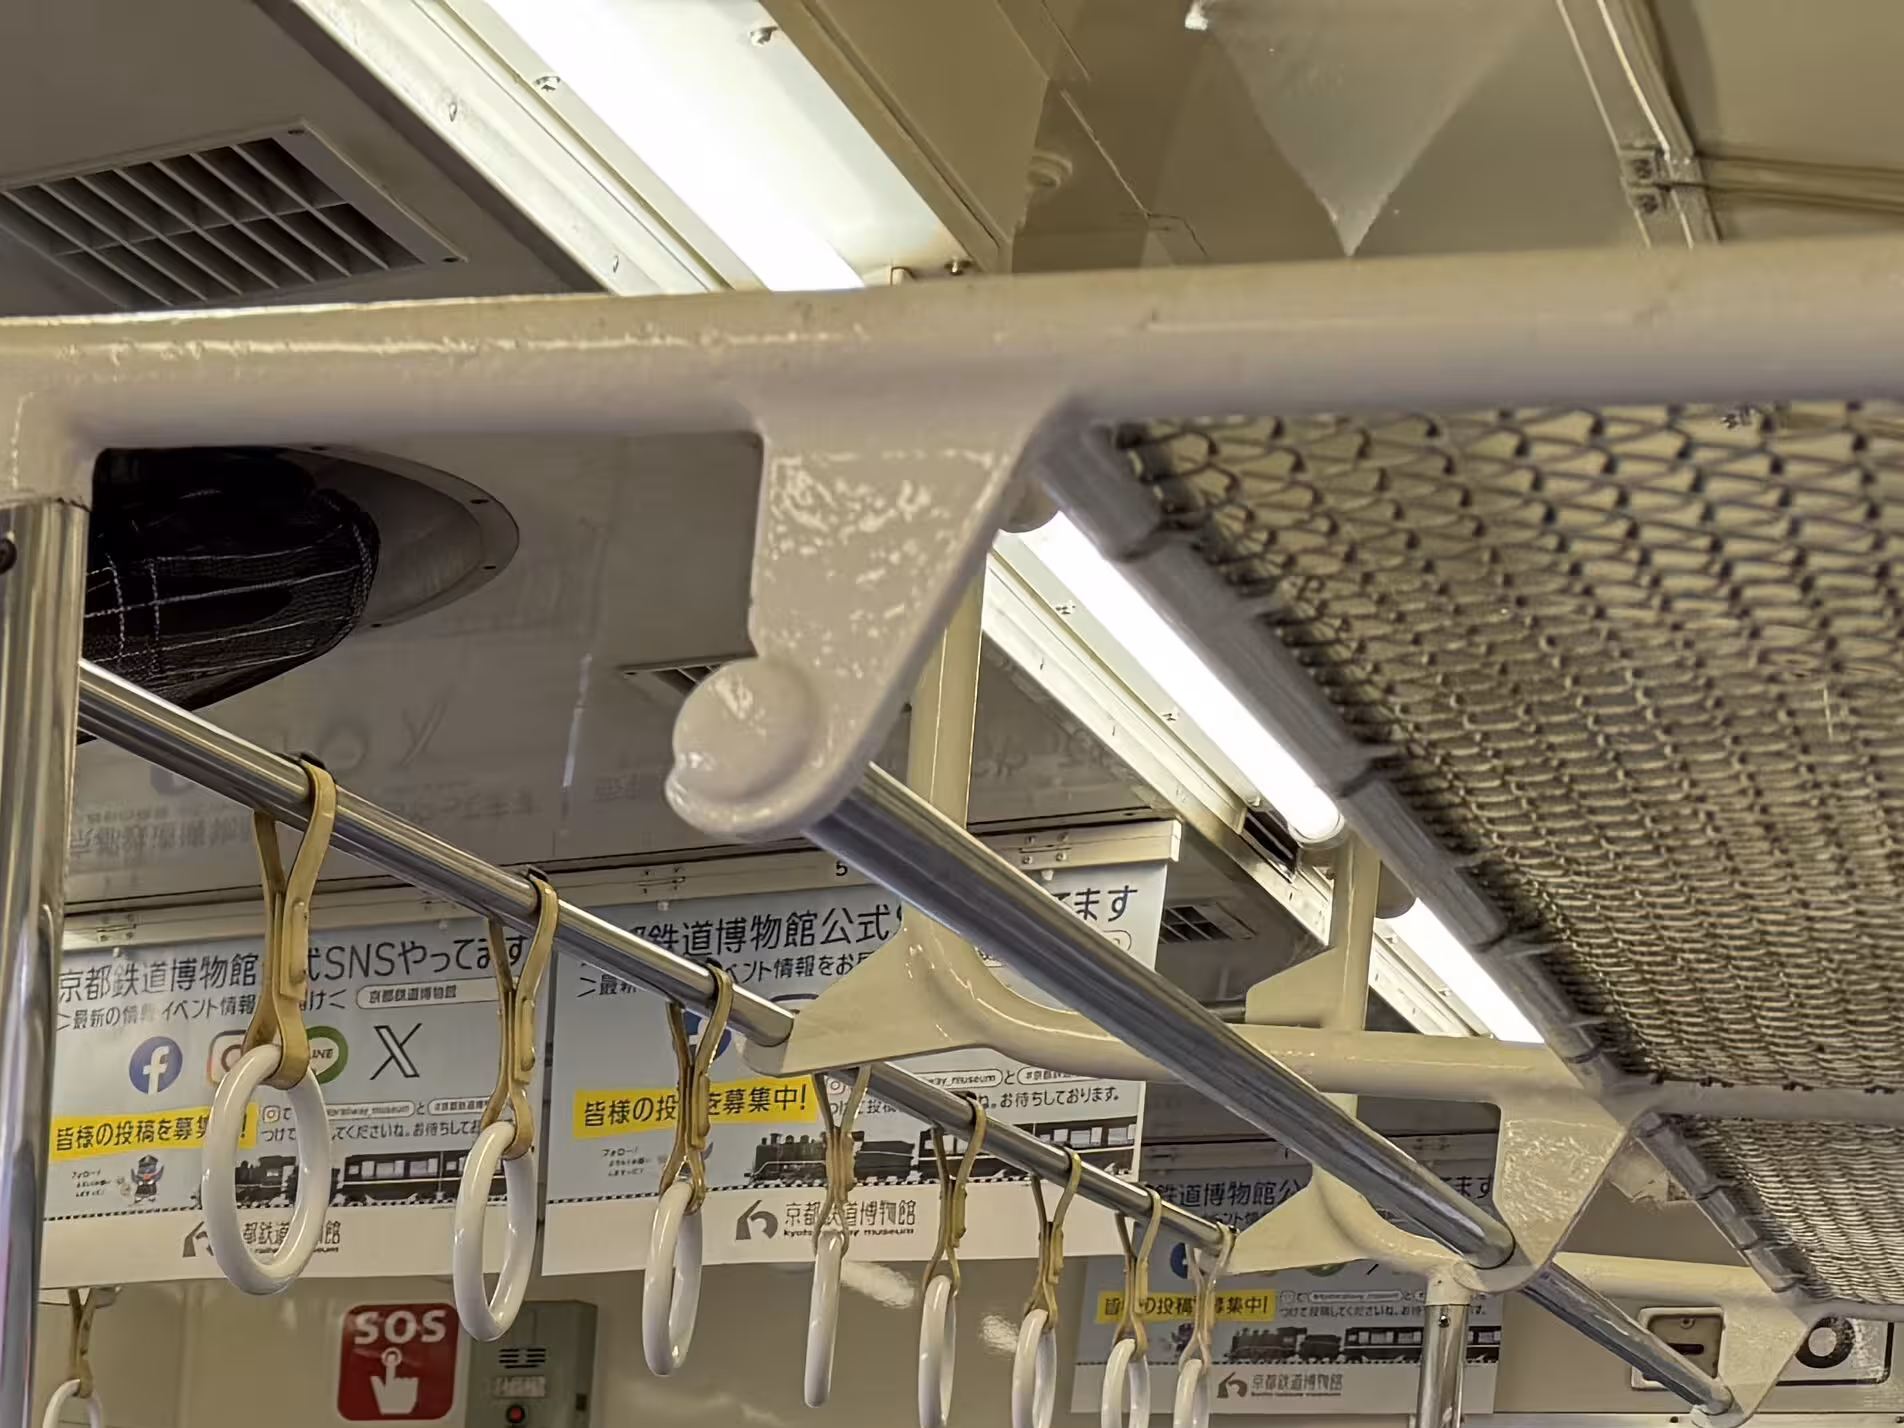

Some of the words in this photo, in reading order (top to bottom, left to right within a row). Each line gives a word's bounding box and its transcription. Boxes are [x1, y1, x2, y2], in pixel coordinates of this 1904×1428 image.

[585, 1085, 806, 1126] 皆様の投を募集中!
[785, 1200, 916, 1226] 京都道博物館
[355, 1310, 446, 1345] SOS
